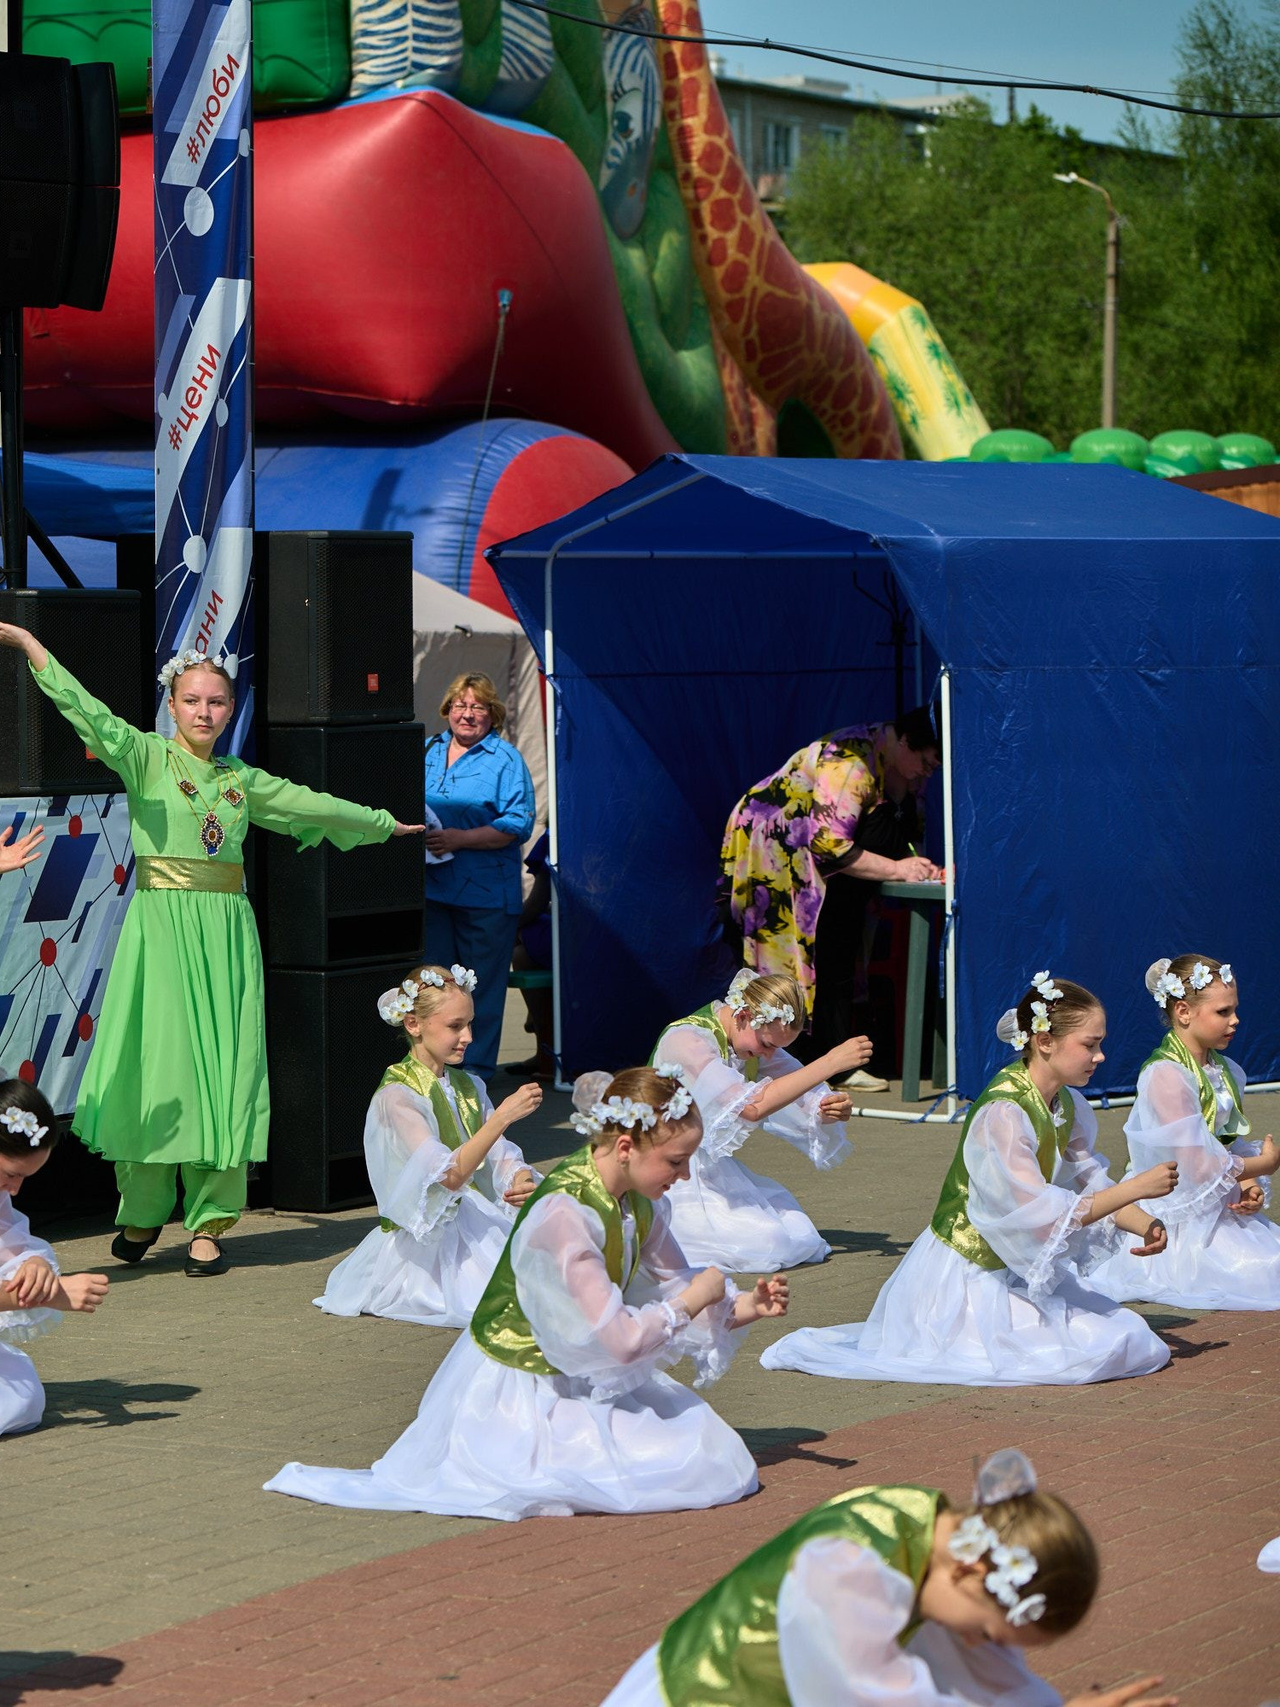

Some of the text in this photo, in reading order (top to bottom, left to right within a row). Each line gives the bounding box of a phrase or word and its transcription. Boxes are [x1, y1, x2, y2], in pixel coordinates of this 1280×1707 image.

[186, 53, 240, 165] #люби
[167, 343, 222, 452] #цени
[195, 589, 224, 655] ани
